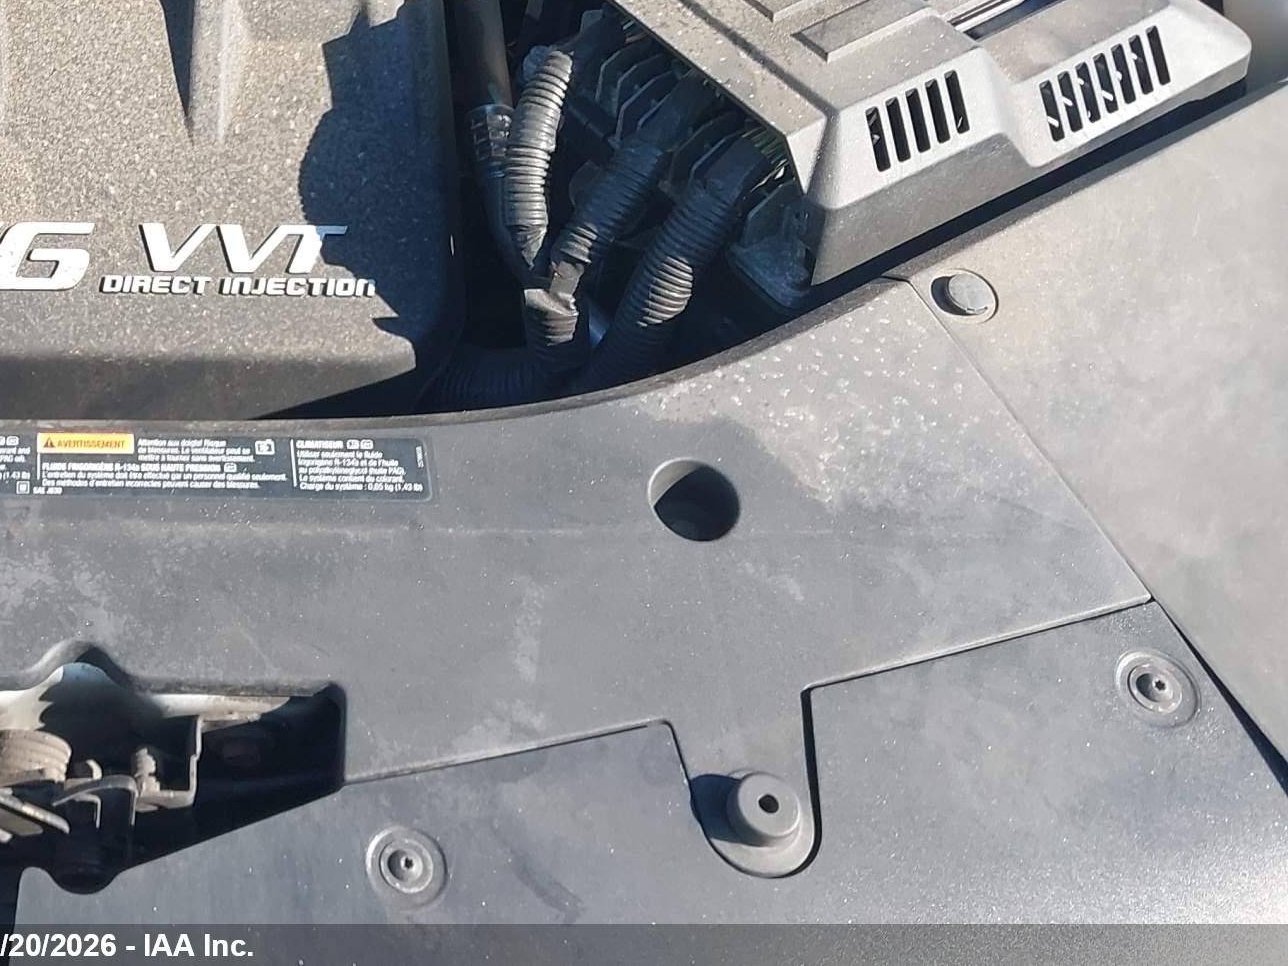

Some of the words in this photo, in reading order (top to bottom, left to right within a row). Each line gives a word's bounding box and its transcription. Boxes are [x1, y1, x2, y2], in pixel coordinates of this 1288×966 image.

[138, 222, 349, 276] VVT
[99, 274, 211, 296] DIRECT
[218, 276, 376, 299] INJECTION
[57, 440, 125, 448] AVERTISSEMENT
